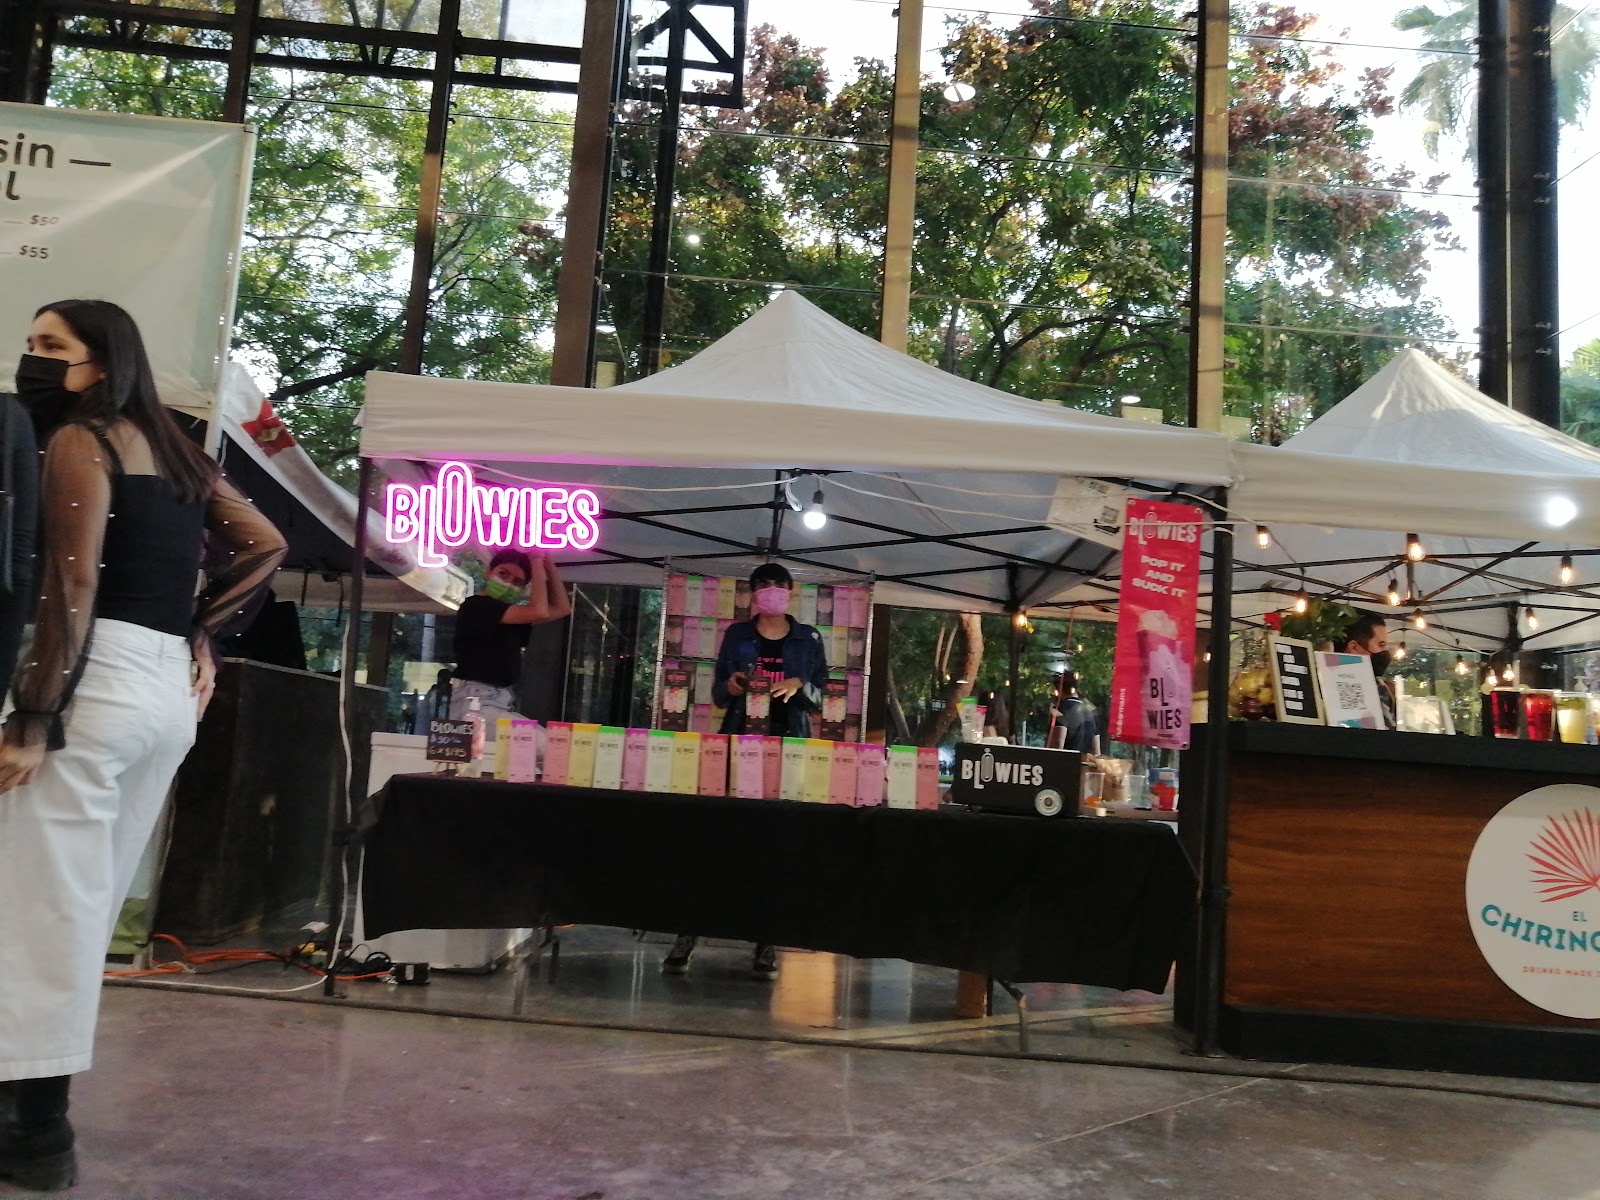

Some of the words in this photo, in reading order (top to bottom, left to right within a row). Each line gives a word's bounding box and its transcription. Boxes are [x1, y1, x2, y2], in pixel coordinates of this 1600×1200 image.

[30, 214, 60, 226] $50
[19, 245, 49, 260] $55
[385, 461, 600, 567] BLOWIES
[1128, 510, 1197, 545] BLOWIES
[1141, 555, 1169, 568] POP
[1170, 562, 1185, 572] IT
[1145, 569, 1175, 583] AND
[1131, 577, 1169, 595] SUCK
[1171, 587, 1186, 598] IT
[1146, 708, 1182, 730] WIES
[961, 751, 1044, 789] BLOWIES
[1572, 910, 1588, 922] EL
[1565, 969, 1593, 977] MADE
